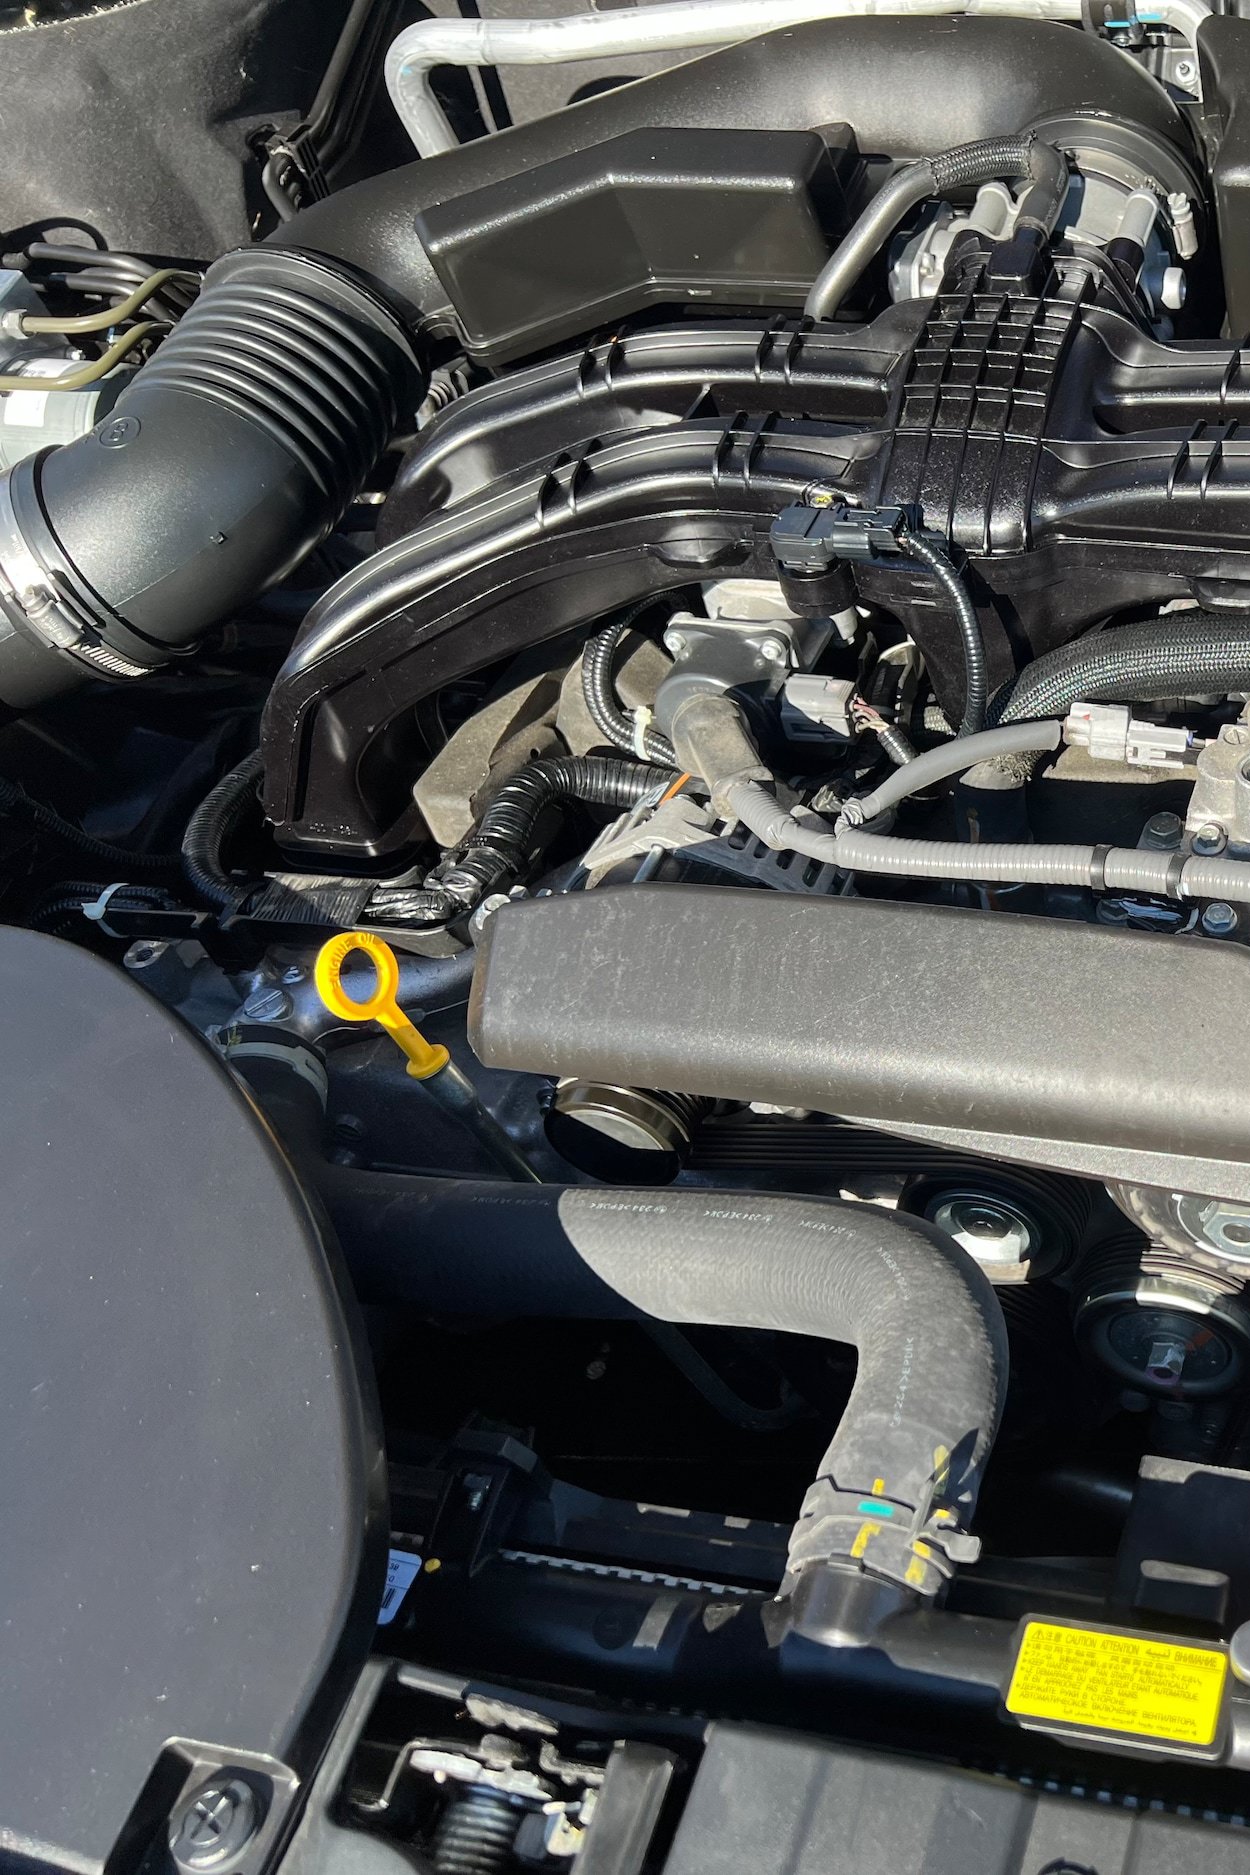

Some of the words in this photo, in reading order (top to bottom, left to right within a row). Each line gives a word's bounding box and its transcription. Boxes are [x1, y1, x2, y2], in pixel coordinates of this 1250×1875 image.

[358, 933, 376, 945] OIL
[1064, 1633, 1097, 1648] CAUTION
[1099, 1638, 1140, 1655] ATTENTION
[1174, 1650, 1217, 1667] ВНИМАНИЕ
